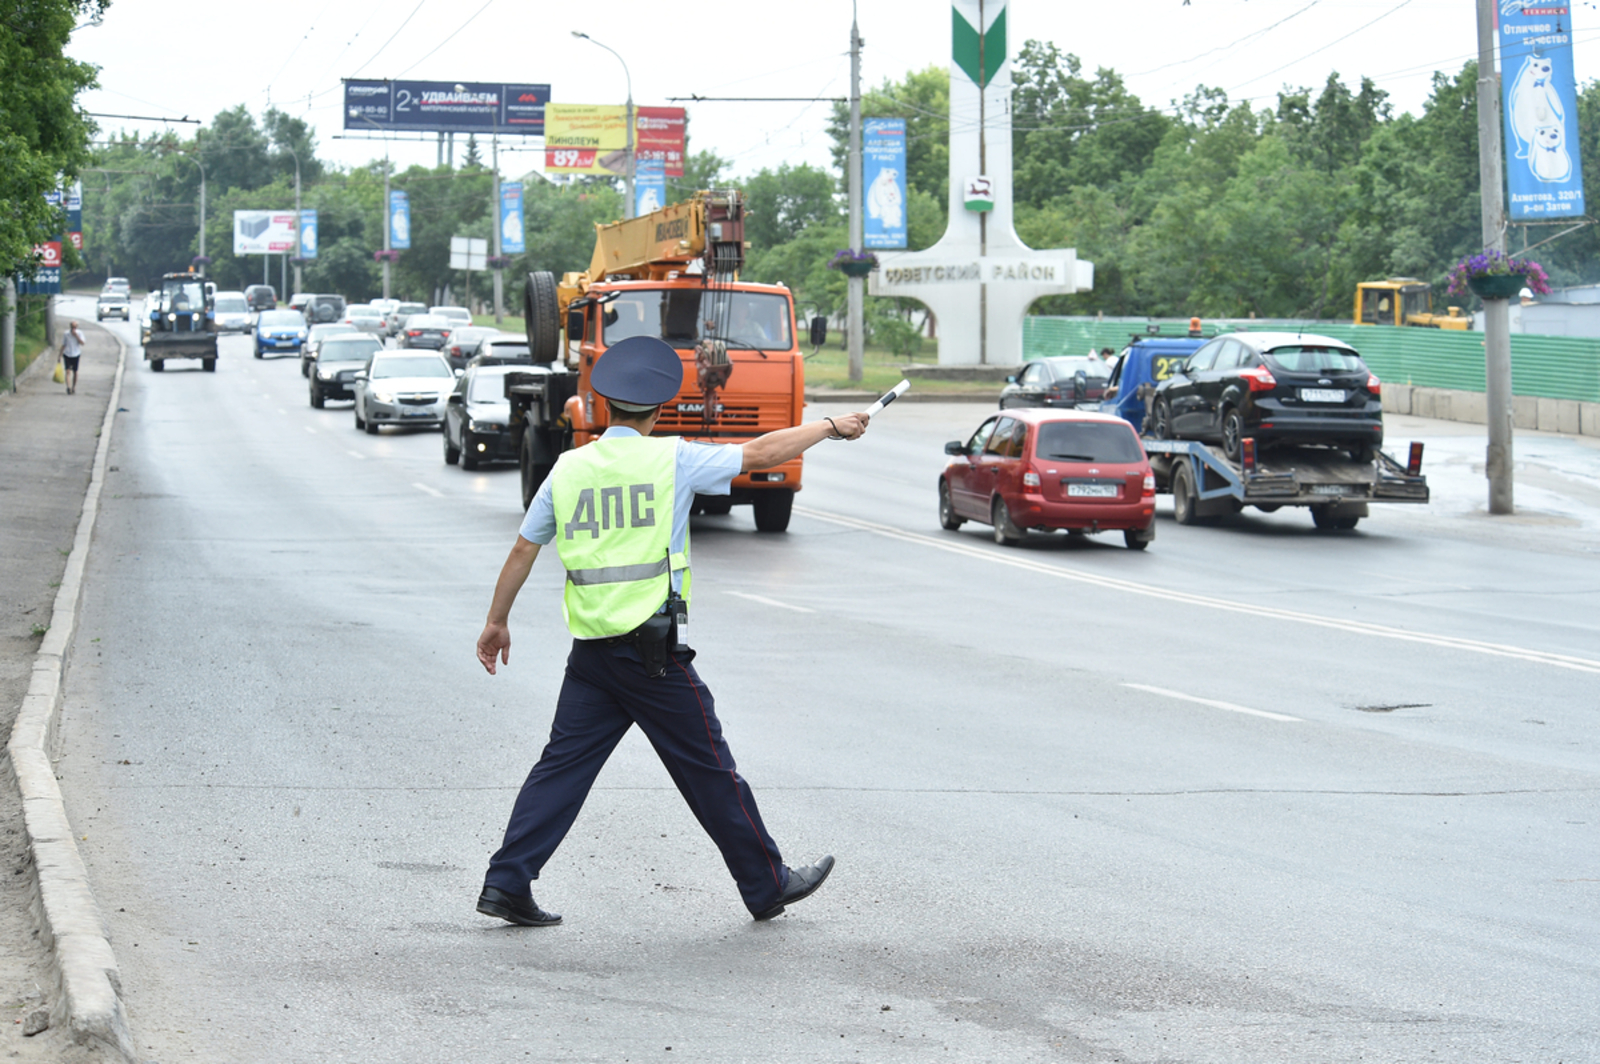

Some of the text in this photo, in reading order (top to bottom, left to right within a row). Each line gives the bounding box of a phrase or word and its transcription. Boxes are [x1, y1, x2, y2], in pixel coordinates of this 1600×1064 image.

[1504, 24, 1551, 35] Отличное
[1523, 35, 1568, 46] качество
[421, 91, 498, 104] УДВАИВАЕМ
[548, 136, 599, 146] ЛИНОЛЕУМ
[554, 149, 579, 167] 89
[1523, 202, 1572, 214] р-он Затон
[885, 261, 1056, 285] СОВЕТСКИЙ РАЙОН
[565, 483, 655, 540] ДПС
